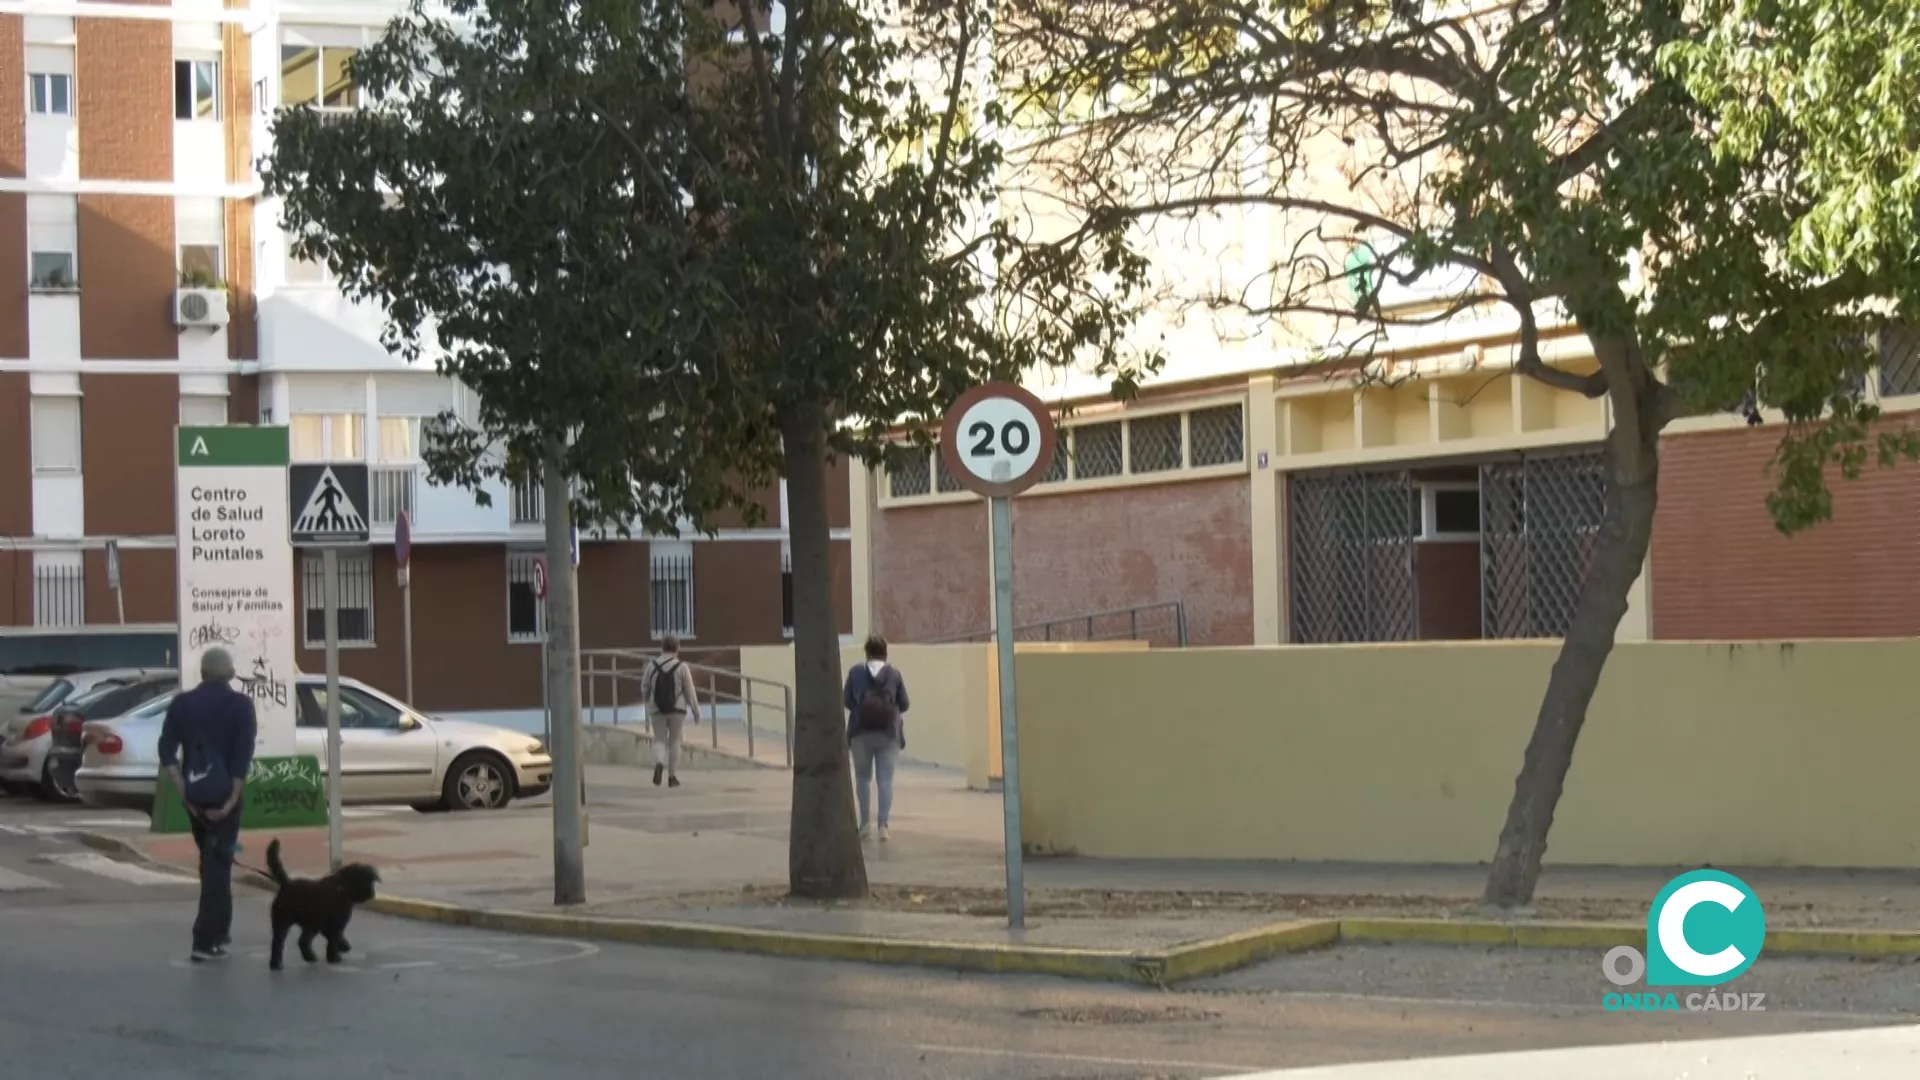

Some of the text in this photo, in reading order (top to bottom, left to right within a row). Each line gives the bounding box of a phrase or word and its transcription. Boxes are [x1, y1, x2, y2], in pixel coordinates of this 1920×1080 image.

[968, 420, 1030, 457] 20
[191, 486, 247, 501] Centro
[191, 505, 263, 521] de Salud
[191, 526, 246, 541] Loreto
[192, 546, 264, 561] Puntales
[254, 587, 269, 599] de
[191, 600, 283, 614] Salud y Familias
